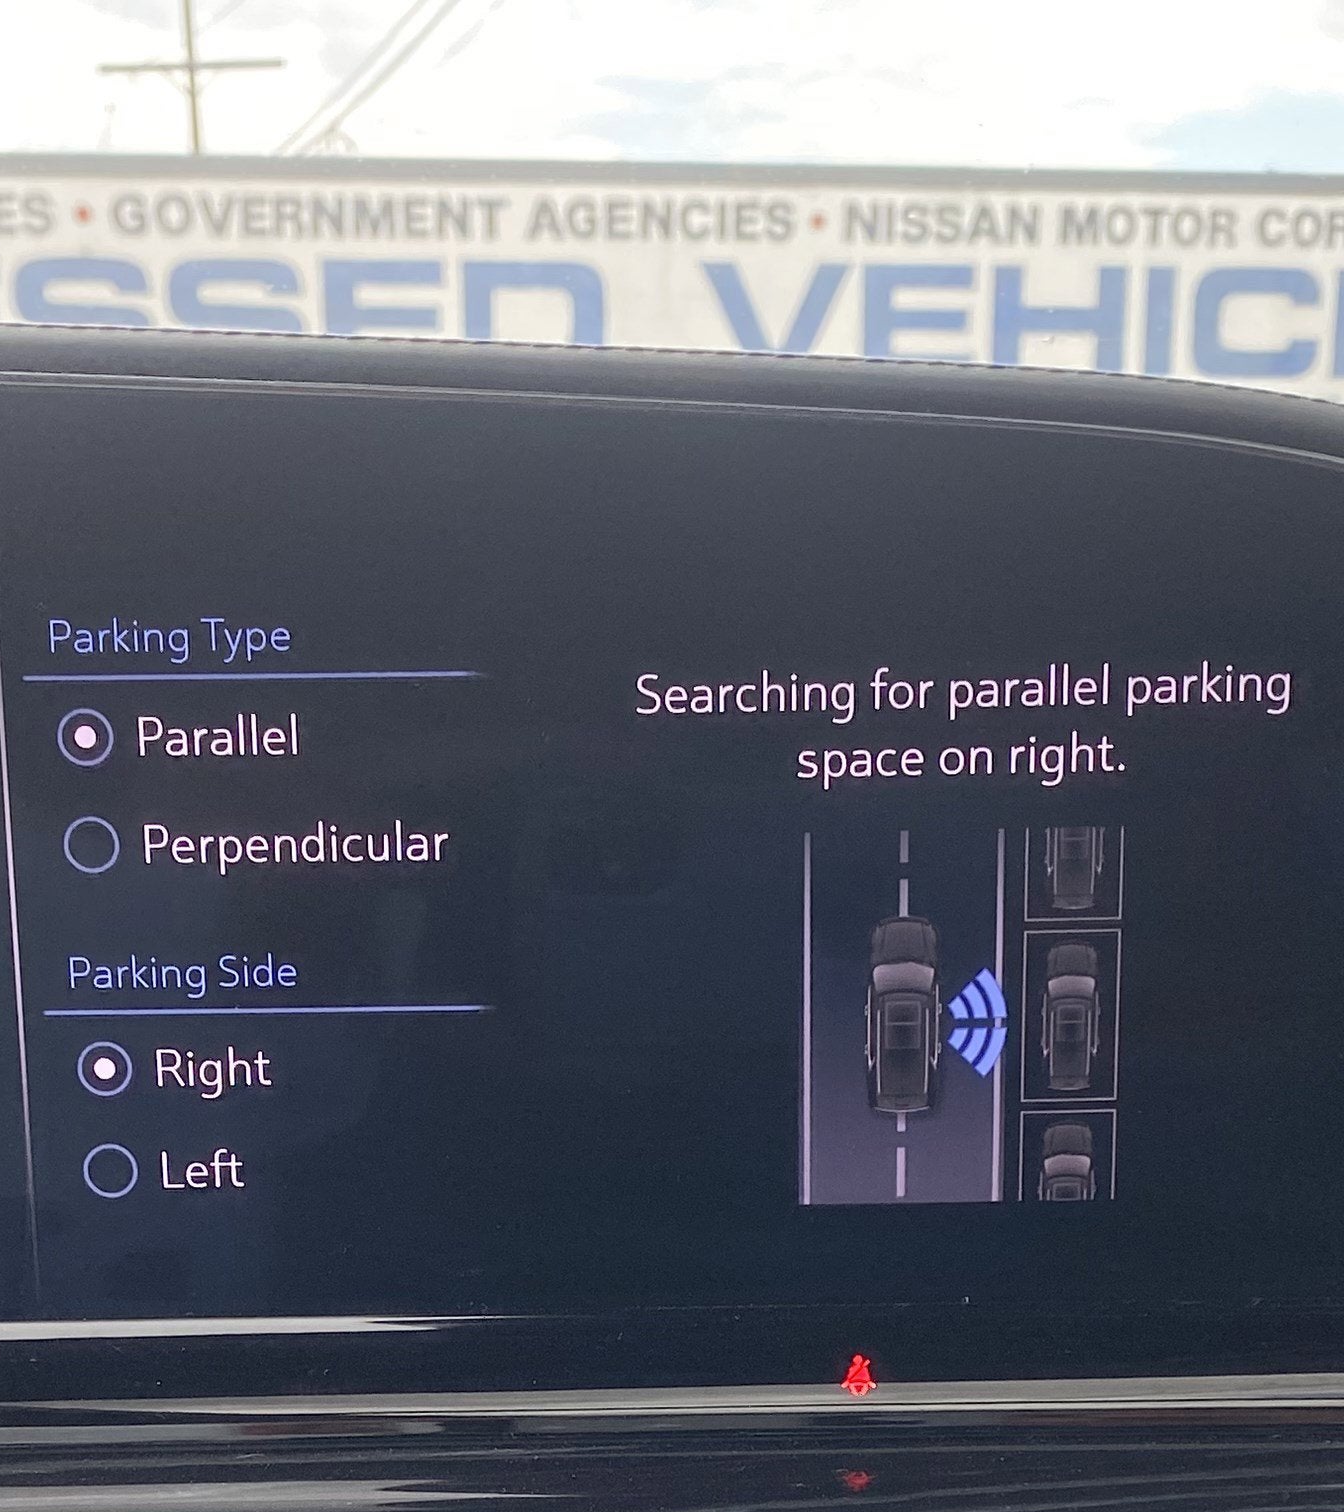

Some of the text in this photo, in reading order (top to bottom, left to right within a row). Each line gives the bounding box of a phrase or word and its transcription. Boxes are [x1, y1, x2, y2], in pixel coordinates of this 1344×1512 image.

[109, 191, 794, 242] GOVERNMENT AGENCIES
[841, 203, 1042, 246] NISSAN
[1058, 206, 1238, 249] MOTOR
[49, 617, 291, 664] Parking Type
[635, 661, 1292, 724] Searching for parallel parking
[137, 712, 299, 757] Parallel
[797, 731, 1126, 790] space on right.
[143, 820, 449, 876] Perpendicular
[68, 952, 298, 998] Parking Side
[155, 1046, 272, 1099] Right
[161, 1147, 245, 1189] Left
